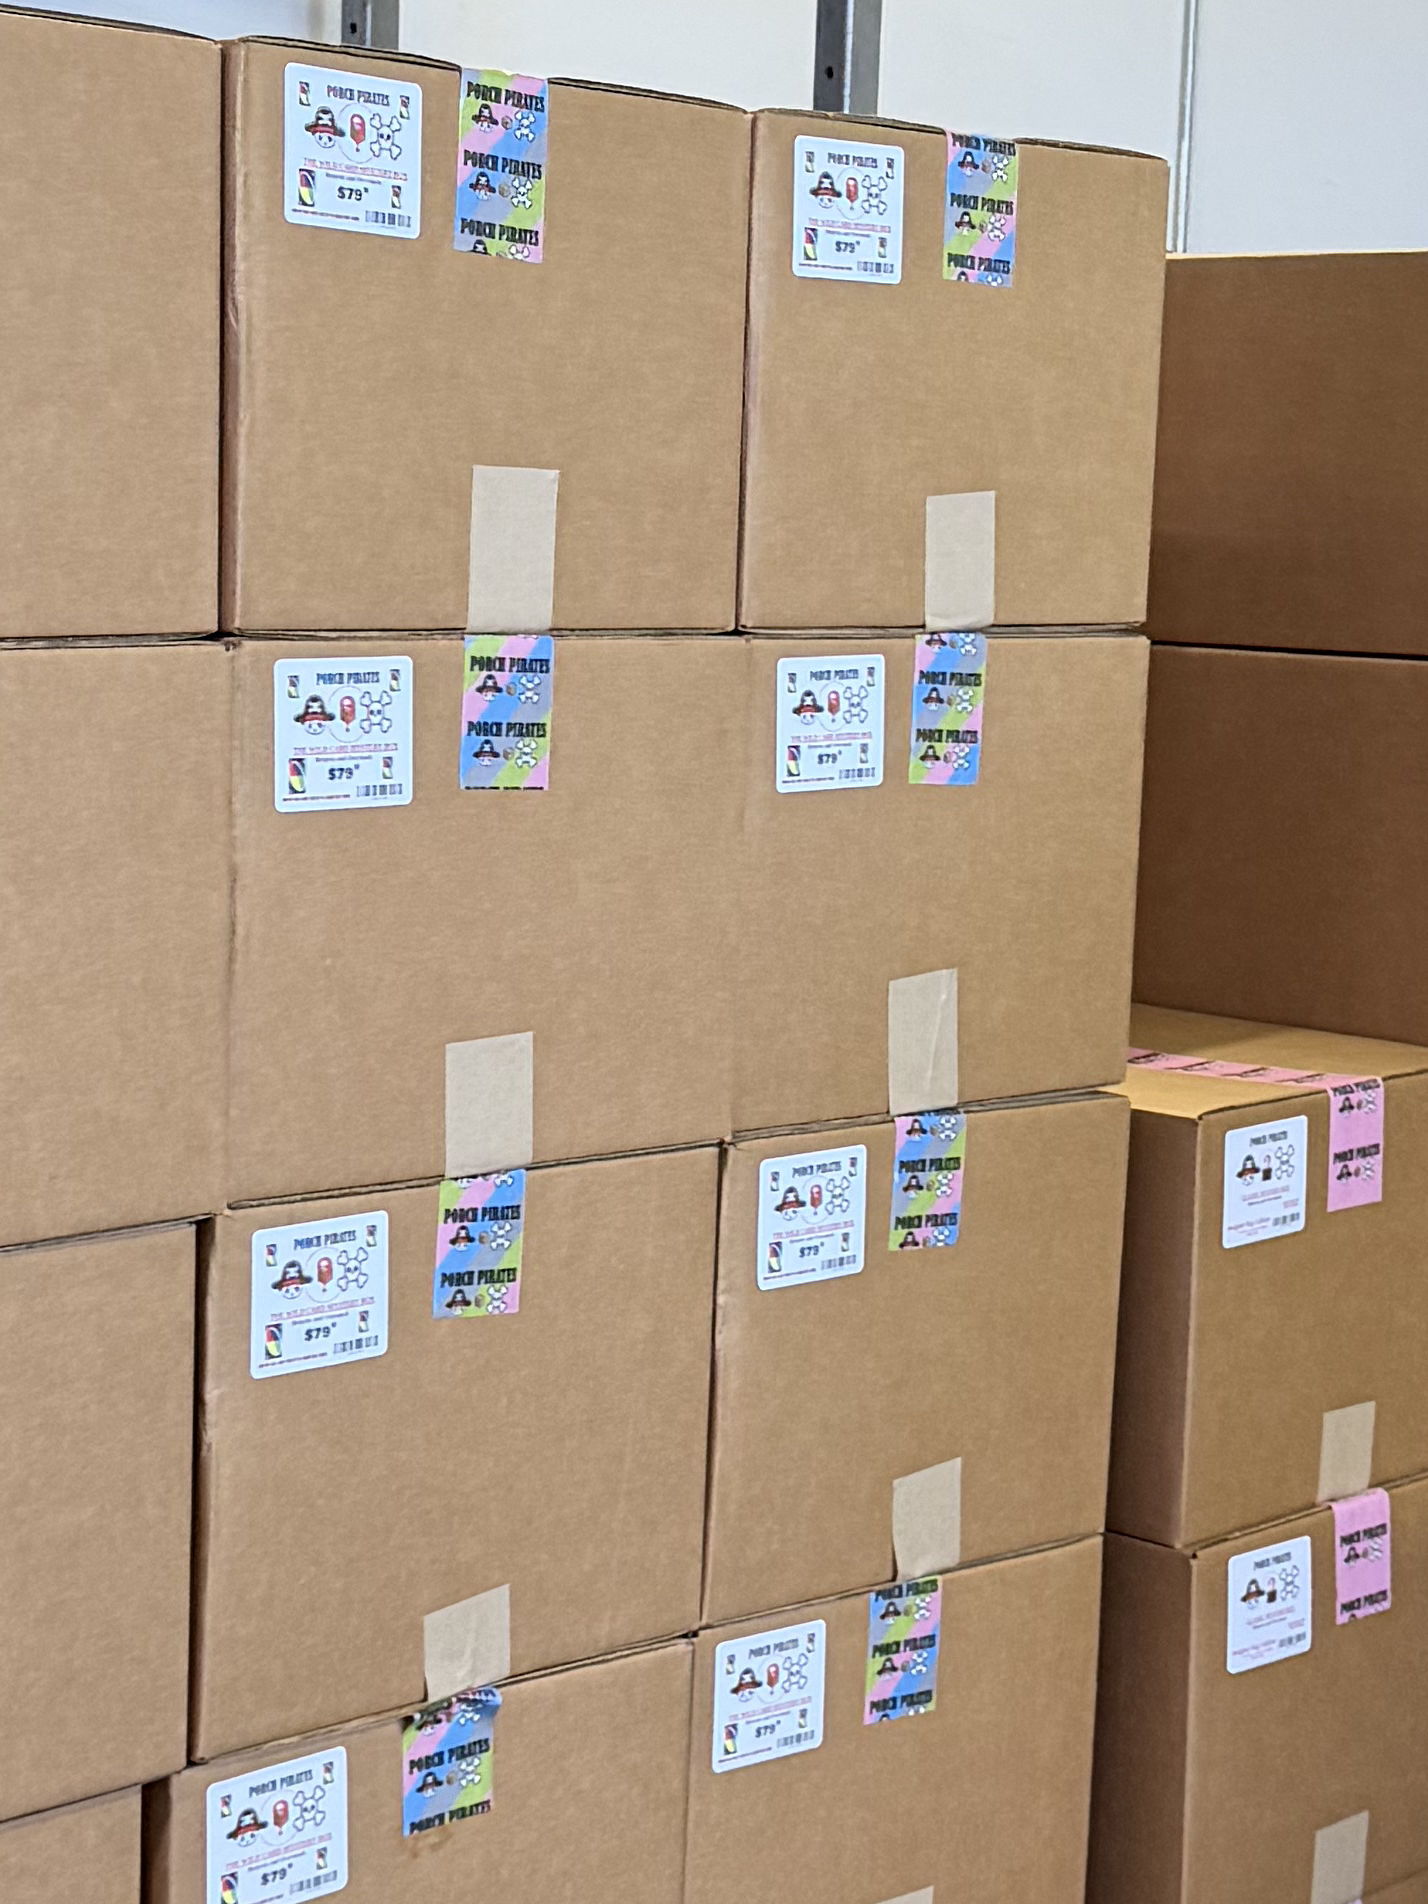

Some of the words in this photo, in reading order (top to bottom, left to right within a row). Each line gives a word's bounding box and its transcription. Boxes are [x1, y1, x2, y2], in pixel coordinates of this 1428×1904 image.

[326, 84, 354, 101] PORCH
[357, 89, 390, 106] PIRATES
[466, 81, 502, 103] PORCH
[504, 88, 545, 113] PIRATES
[463, 149, 499, 171] PORCH
[501, 157, 542, 180] PIRATES
[950, 193, 978, 209] PORCH
[981, 198, 1014, 215] PIRATES
[460, 217, 497, 238] PORCH
[499, 224, 539, 246] PIRATES
[947, 253, 975, 268] PORCH
[977, 256, 1010, 274] PIRATES
[470, 656, 506, 672] PORCH
[508, 657, 550, 674] PIRATES
[316, 672, 344, 684] PORCH
[347, 671, 380, 684] PIRATES
[467, 721, 503, 737] PORCH
[505, 722, 547, 738] PIRATES
[444, 1208, 478, 1224] PORCH
[481, 1204, 521, 1221] PIRATES
[293, 1236, 322, 1250] PORCH
[324, 1230, 356, 1246] PIRATES
[440, 1272, 474, 1288] PORCH
[477, 1268, 517, 1284] PIRATES
[409, 1752, 445, 1775] PORCH
[447, 1738, 490, 1763] PIRATES
[249, 1780, 277, 1798] PORCH
[280, 1769, 313, 1789] PIRATES
[409, 1814, 445, 1836] PORCH
[448, 1800, 491, 1823] PIRATES
